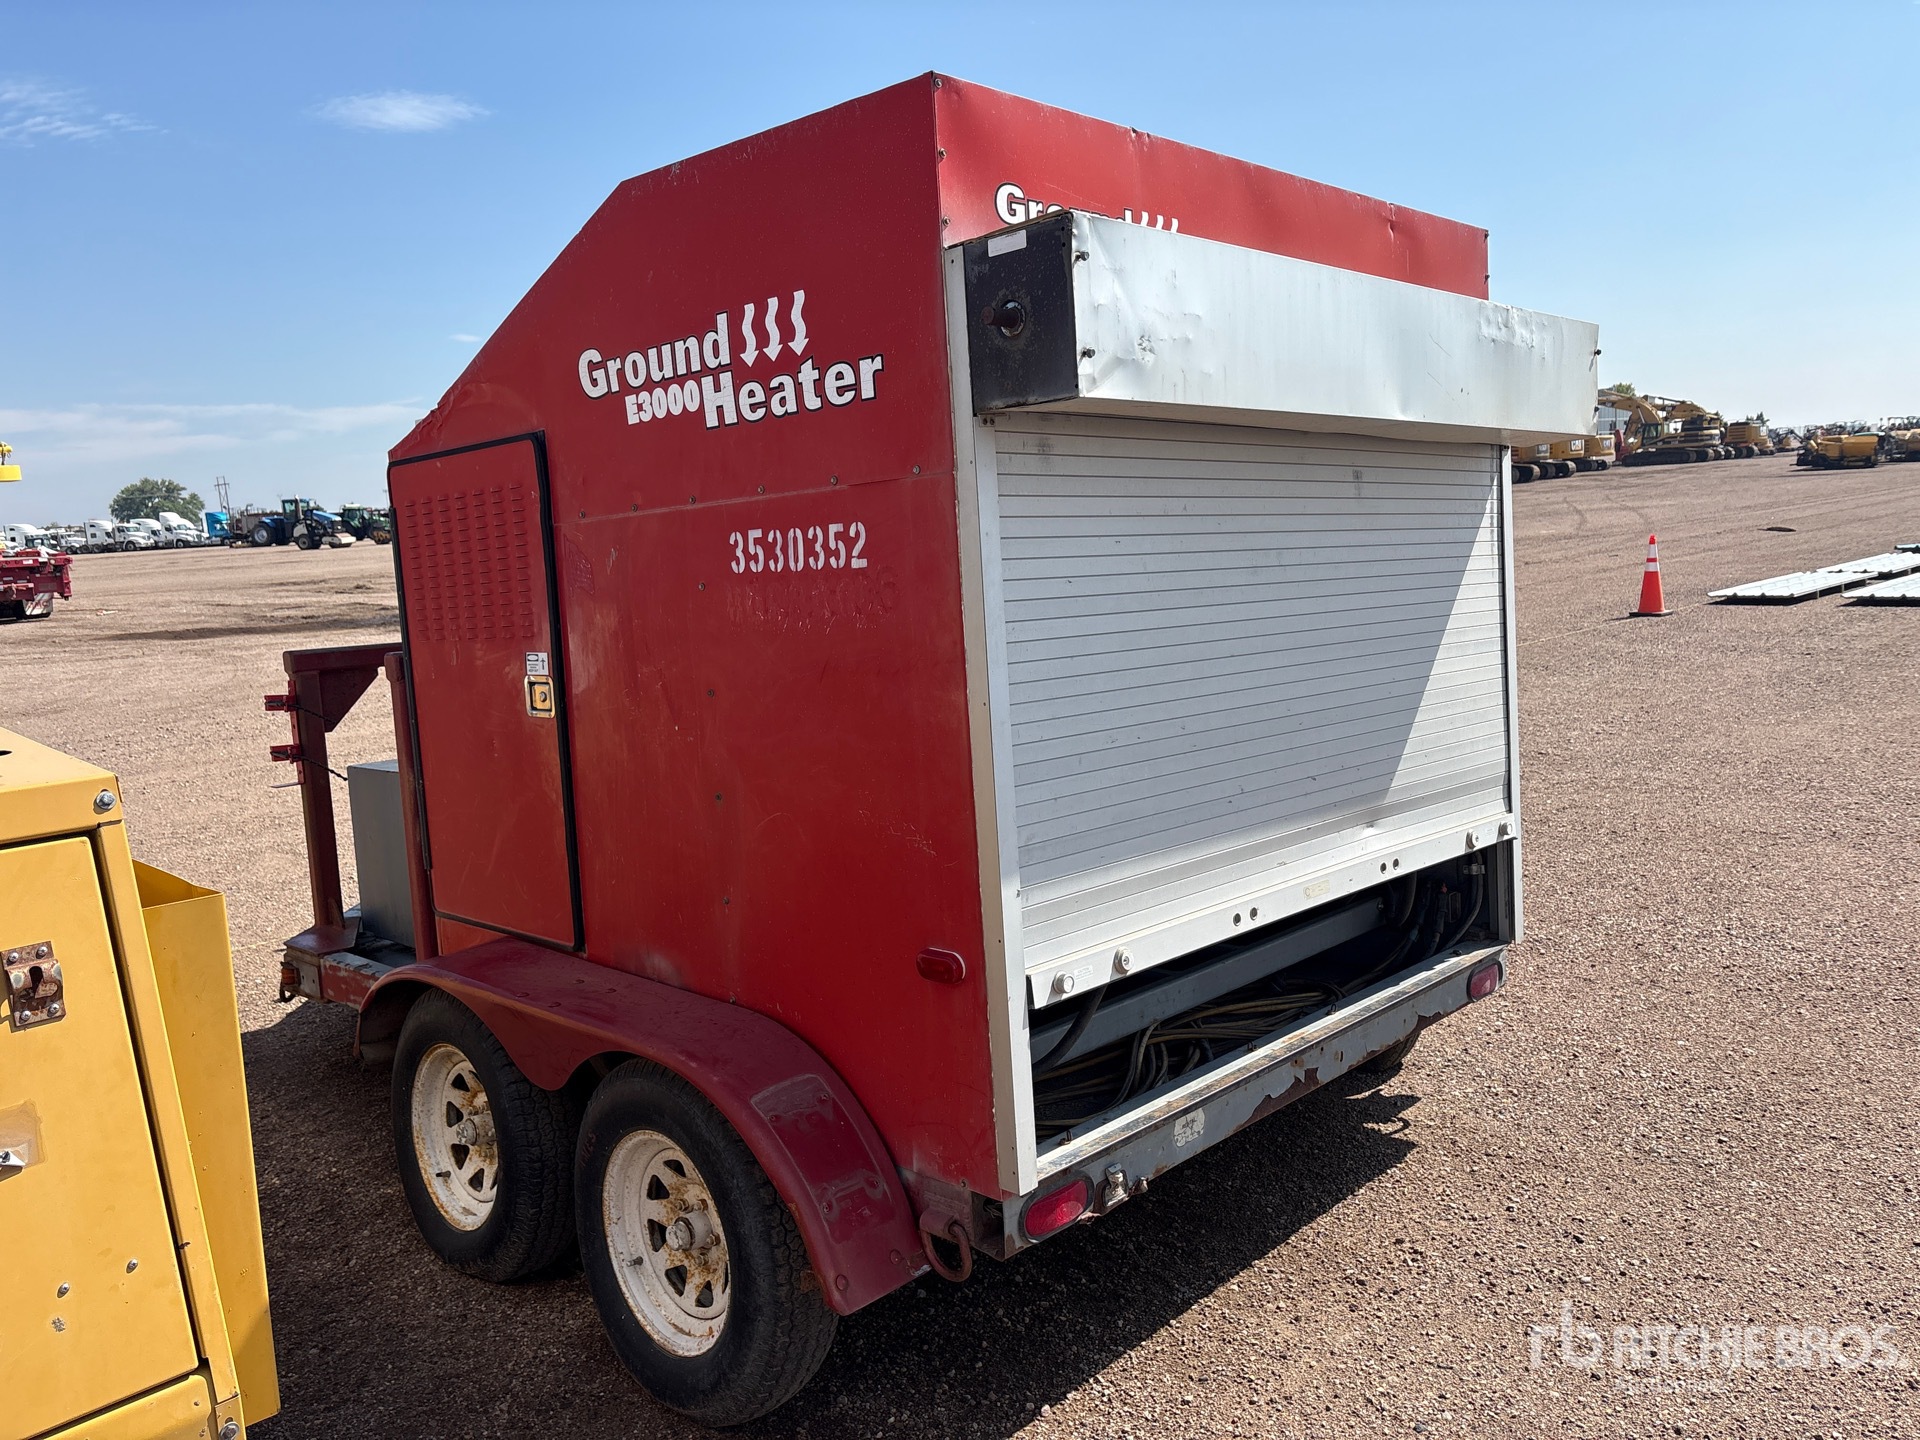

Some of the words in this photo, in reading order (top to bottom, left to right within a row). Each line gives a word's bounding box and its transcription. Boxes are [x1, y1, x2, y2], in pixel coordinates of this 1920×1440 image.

[578, 311, 731, 399] Ground
[625, 379, 700, 425] E3000
[700, 353, 884, 430] Heater
[729, 521, 868, 574] 3530352
